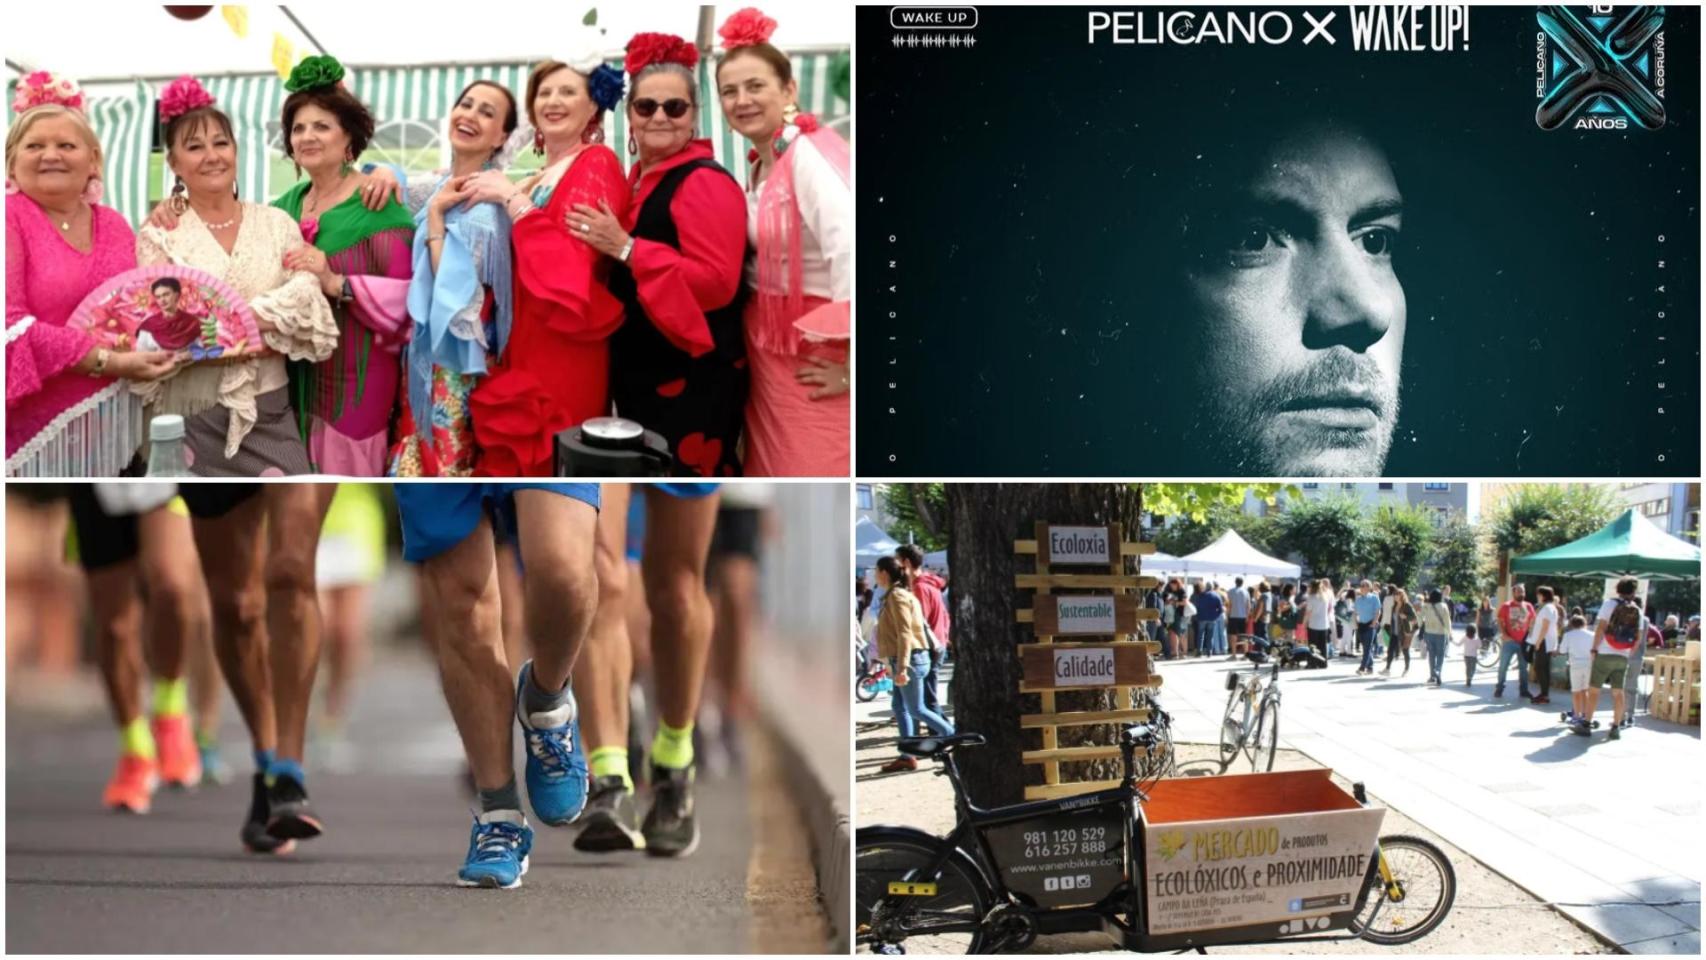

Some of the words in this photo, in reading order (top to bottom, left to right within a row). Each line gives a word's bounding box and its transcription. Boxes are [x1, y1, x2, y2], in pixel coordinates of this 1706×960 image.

[901, 12, 943, 23] WAKE
[948, 12, 968, 23] UP
[1087, 11, 1293, 44] PELICANO
[1349, 5, 1426, 51] WAKE
[1430, 5, 1470, 51] UP!
[1537, 31, 1545, 98] PELICANO
[1655, 31, 1665, 87] CORUÑA
[1656, 88, 1665, 98] A
[1574, 115, 1628, 130] AÑOS
[1051, 532, 1106, 555] Ecoloxía
[1058, 603, 1113, 619] Sustentable
[1055, 654, 1113, 678] Calidade
[1023, 832, 1047, 845] 981
[1053, 829, 1077, 842] 120
[1082, 827, 1105, 840] 529
[1193, 827, 1279, 862] MERCADO
[1025, 845, 1050, 858] 616
[1054, 843, 1077, 856] 257
[1081, 841, 1106, 853] 888
[1010, 858, 1122, 873] www.vanenbikke.com
[1155, 864, 1248, 898] ECOLÓXICOS
[1252, 868, 1262, 888] e
[1266, 854, 1365, 887] PROXIMIDADE
